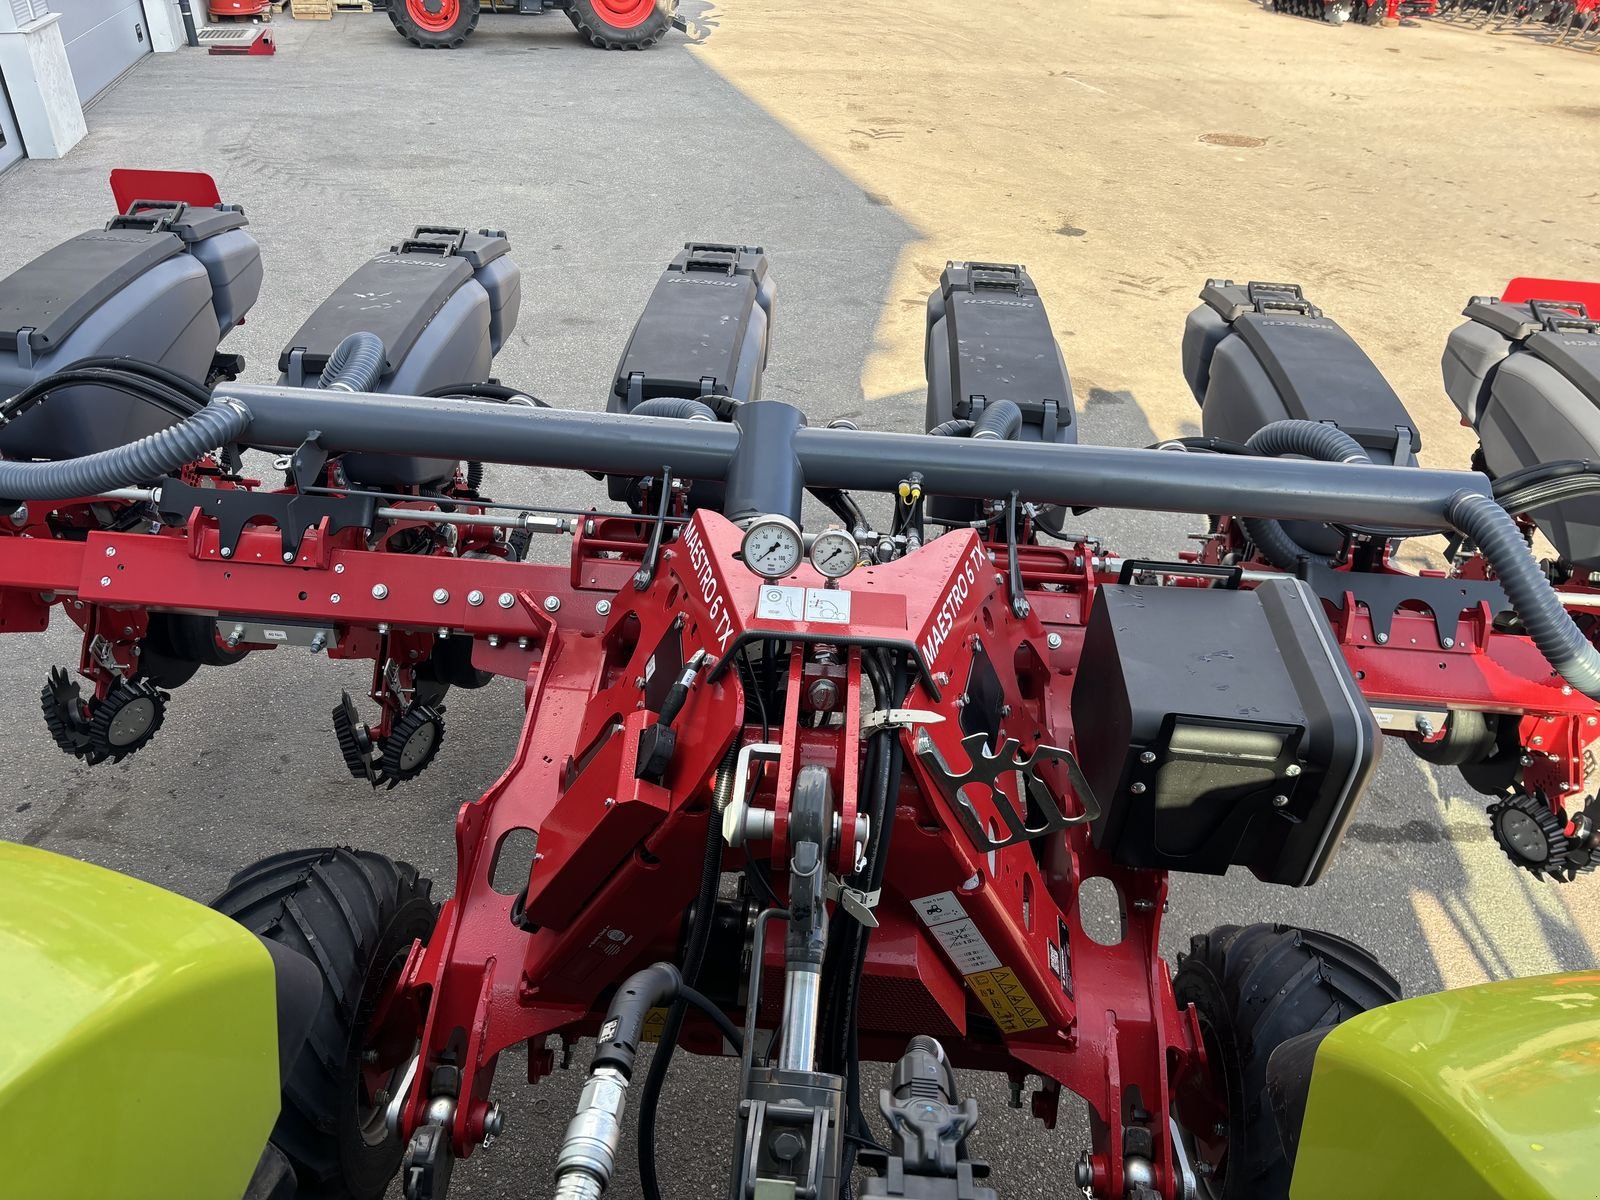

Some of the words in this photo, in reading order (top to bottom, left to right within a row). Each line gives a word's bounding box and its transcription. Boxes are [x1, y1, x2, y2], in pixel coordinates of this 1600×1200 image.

[667, 278, 738, 287] HORSCH
[963, 299, 1034, 308] HORSCH
[683, 518, 717, 604] MAESTRO
[969, 540, 986, 572] TX
[965, 560, 975, 585] 6
[709, 595, 724, 620] 6
[921, 573, 969, 670] MAESTRO
[715, 607, 735, 653] TX
